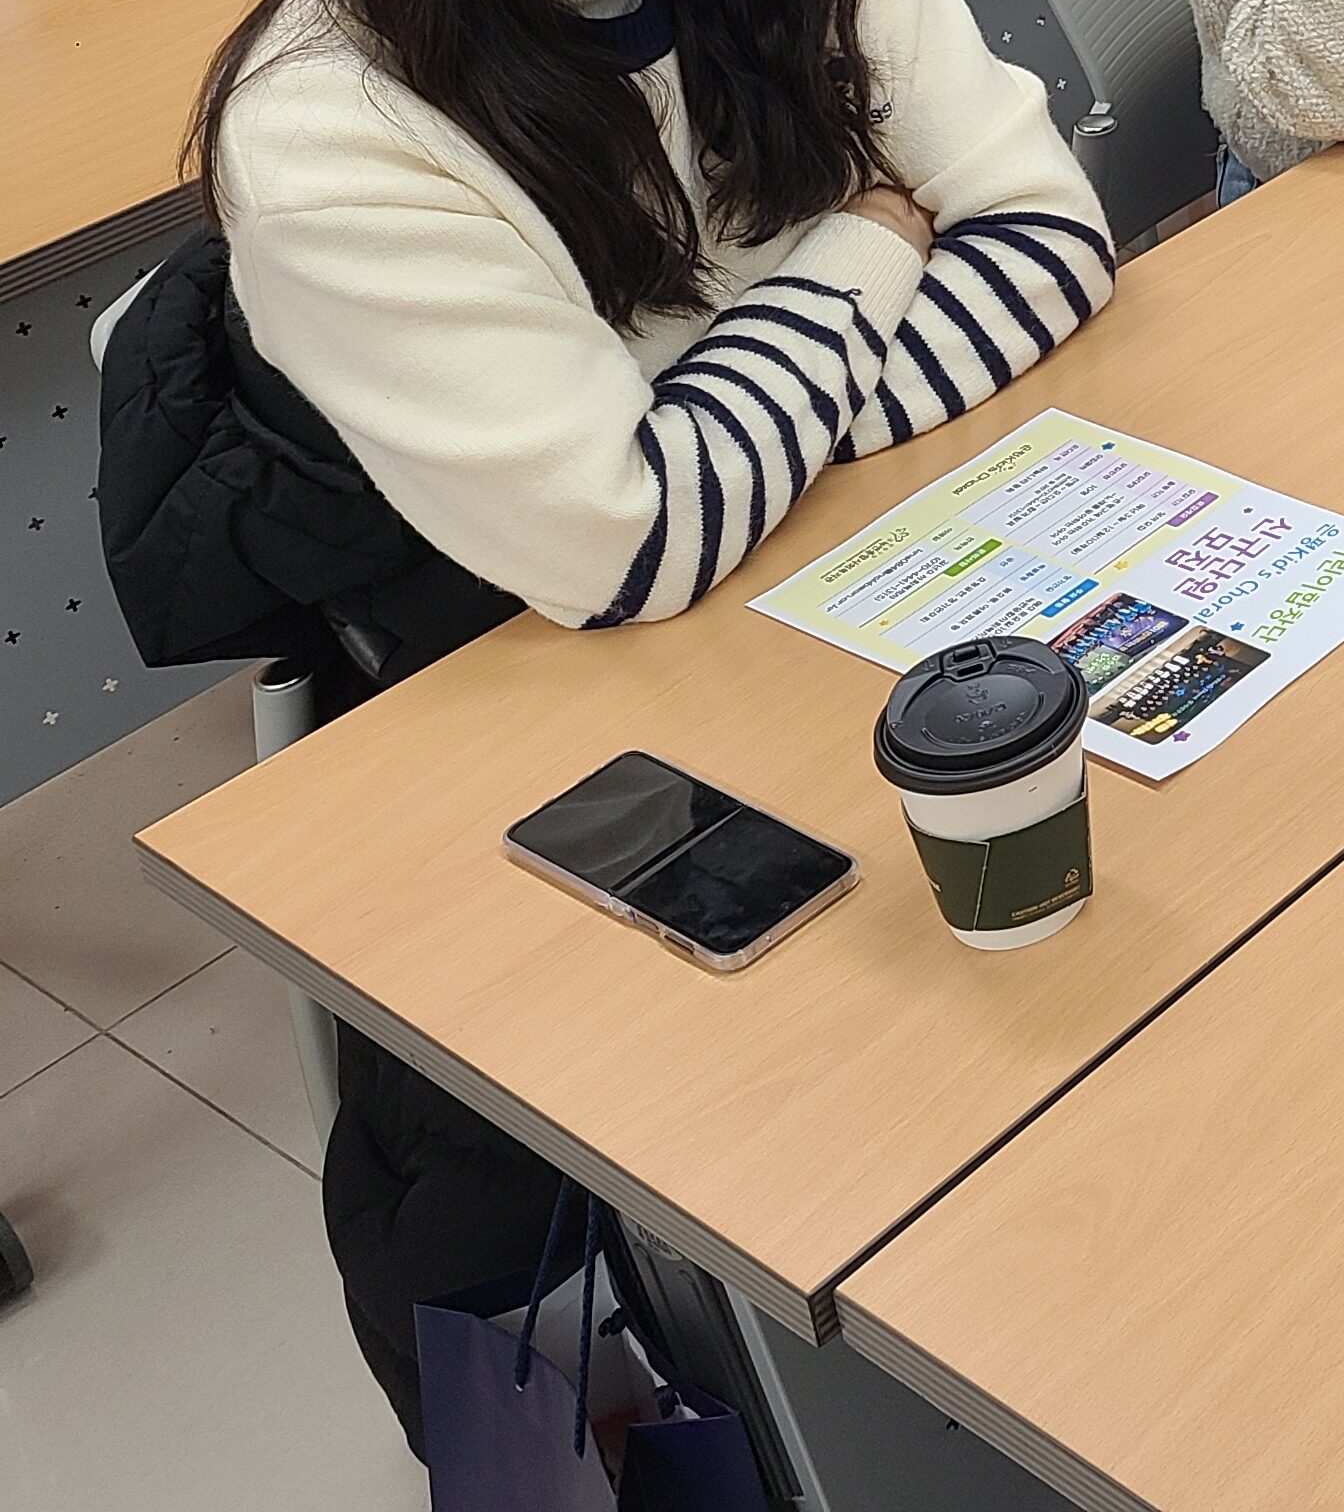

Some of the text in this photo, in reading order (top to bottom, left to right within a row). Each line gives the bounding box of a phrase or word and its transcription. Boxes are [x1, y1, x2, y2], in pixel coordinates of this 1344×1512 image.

[1164, 526, 1234, 571] 모집
[1172, 517, 1292, 600] 신규단원
[1192, 523, 1339, 624] 은평Kid's Choral
